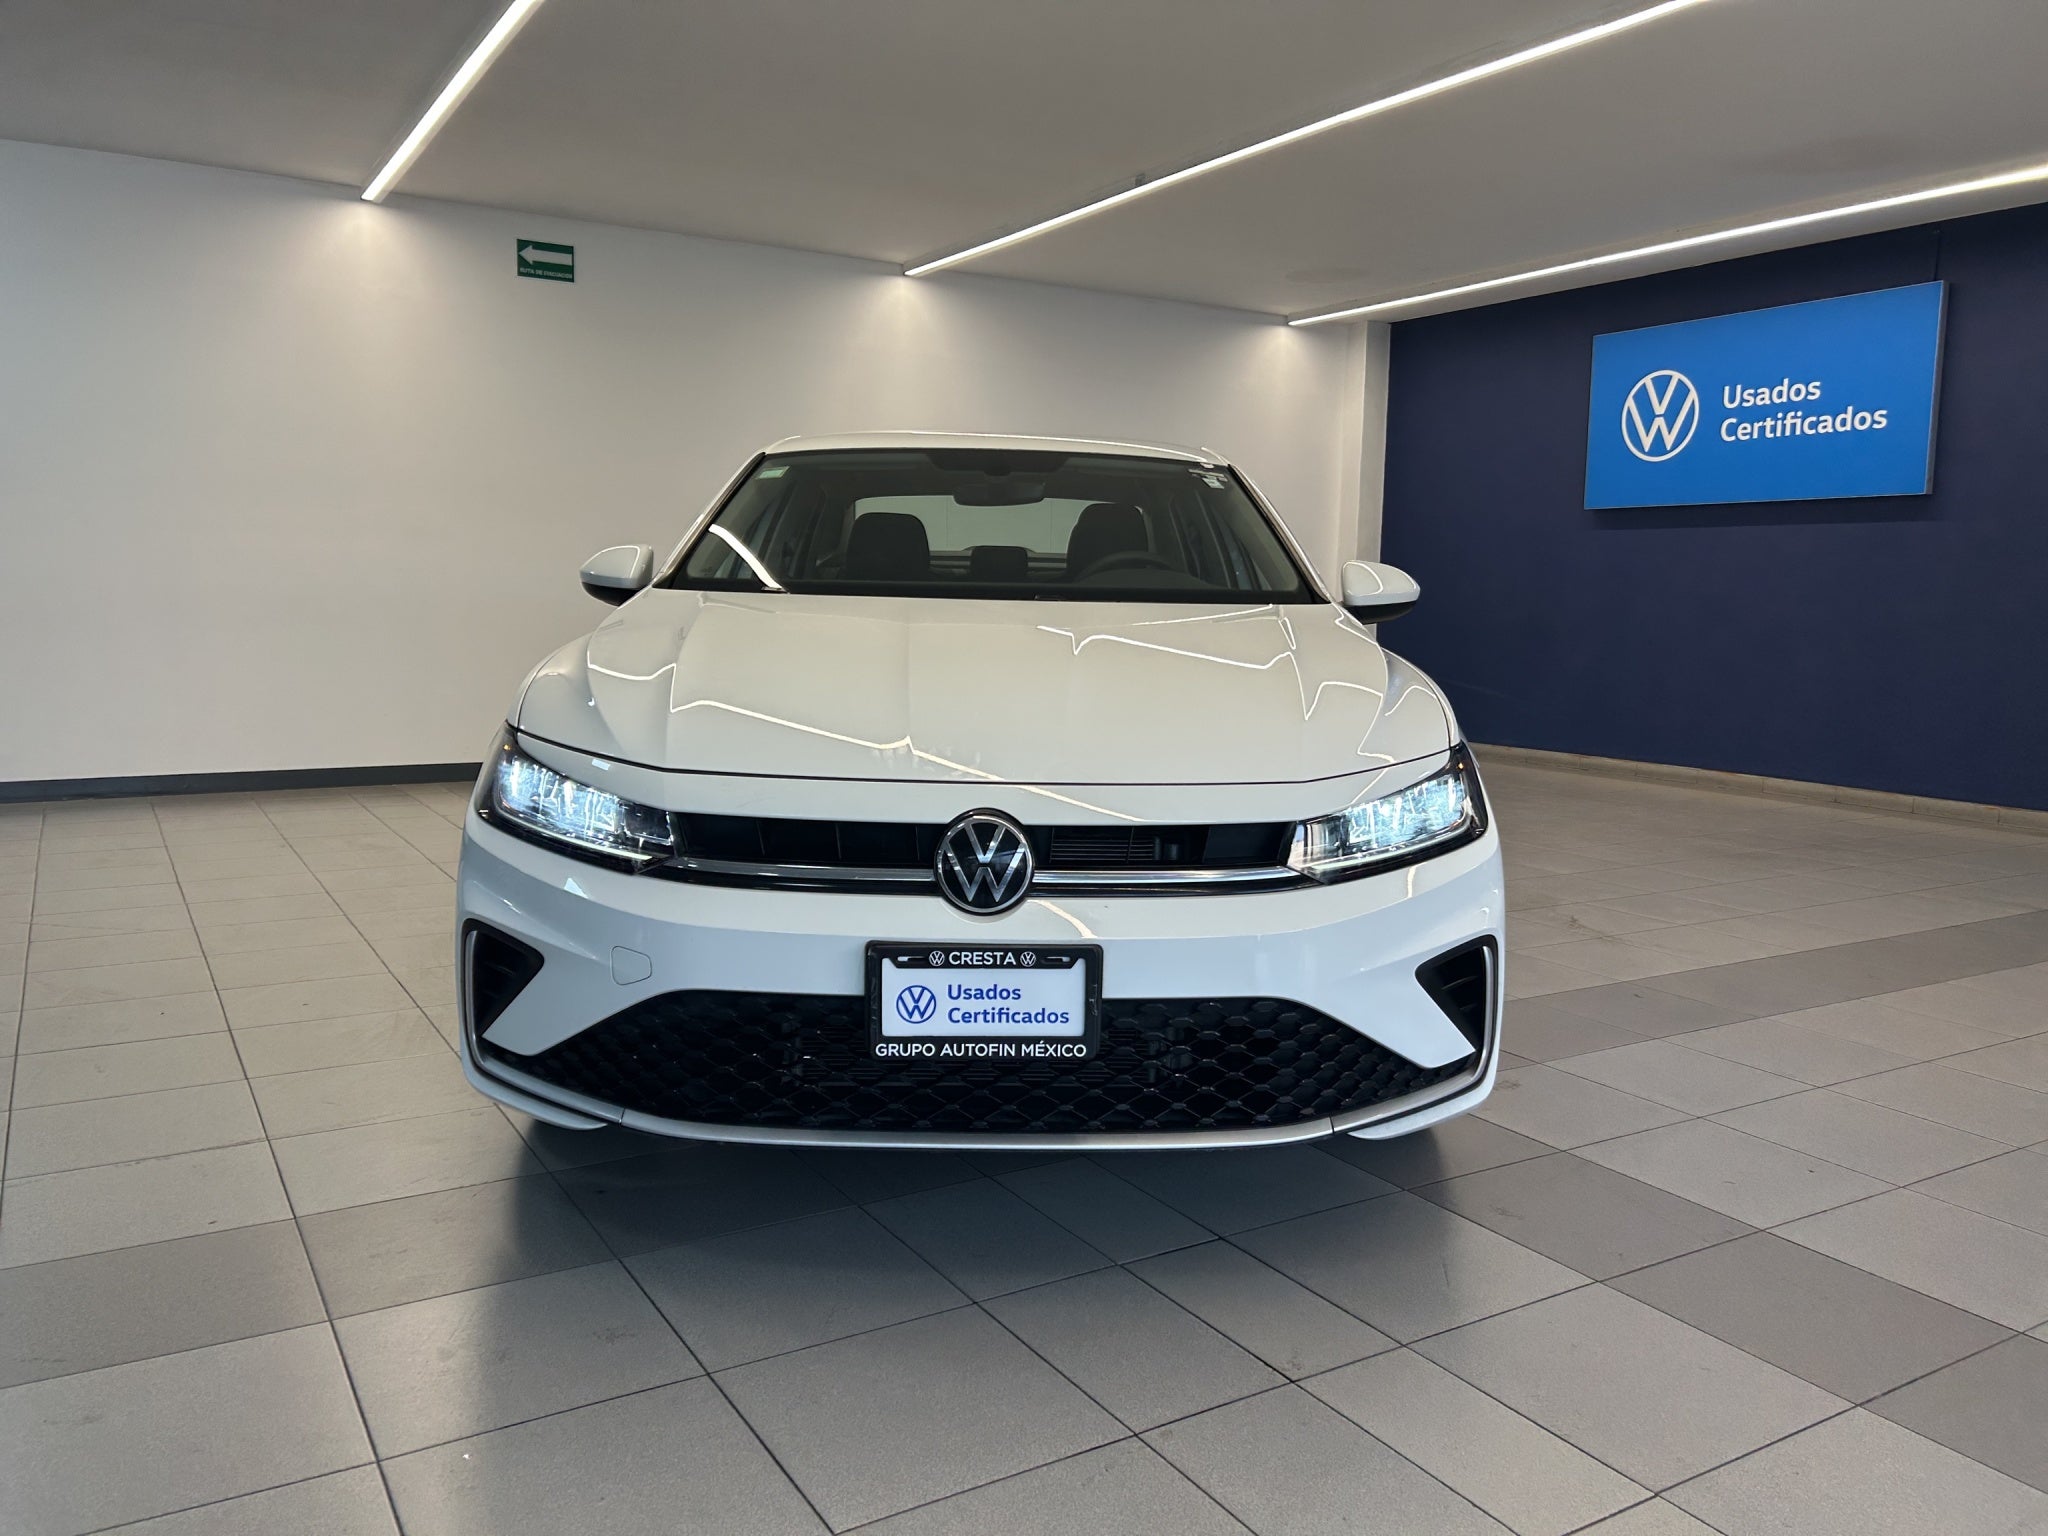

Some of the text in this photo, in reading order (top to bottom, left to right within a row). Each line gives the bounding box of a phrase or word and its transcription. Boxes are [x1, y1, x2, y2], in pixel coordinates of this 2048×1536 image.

[1723, 378, 1821, 409] Usados
[1621, 369, 1699, 462] VW
[1720, 406, 1887, 442] Certificados
[937, 814, 1033, 913] VW
[949, 952, 1016, 966] CRESTA
[896, 985, 937, 1024] VW
[947, 984, 1021, 1000] Usados
[947, 1007, 1070, 1024] Certificados
[875, 1040, 1087, 1057] GRUPO AUTOFIN MÉXICO
